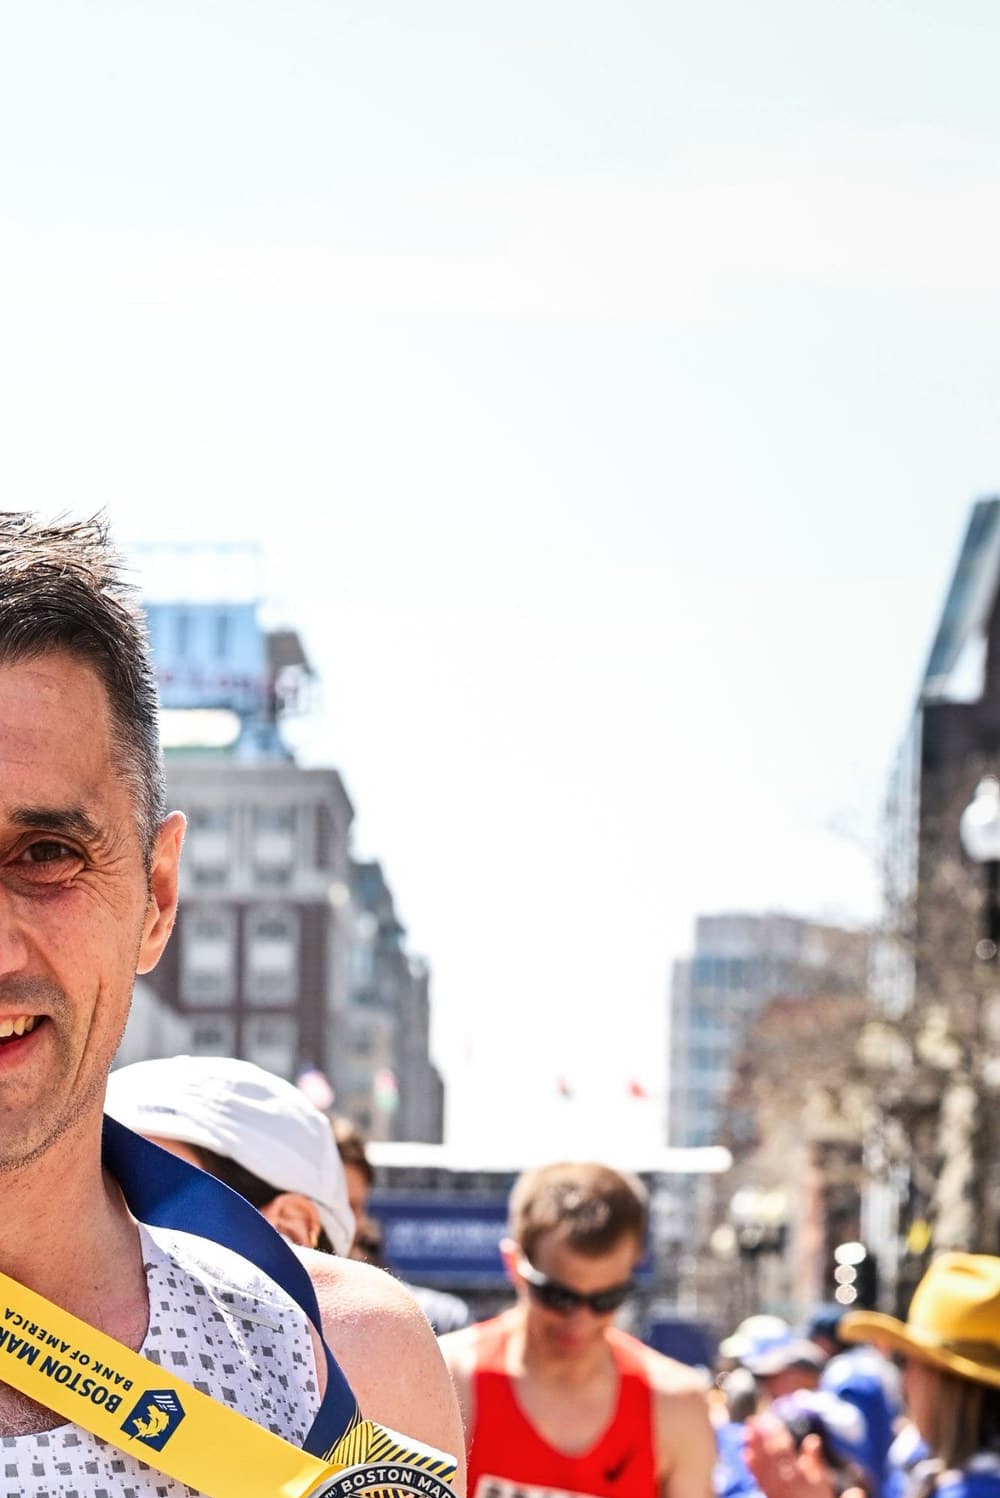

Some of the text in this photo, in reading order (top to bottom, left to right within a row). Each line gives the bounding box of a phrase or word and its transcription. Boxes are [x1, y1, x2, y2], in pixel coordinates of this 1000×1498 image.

[4, 1307, 134, 1391] BANK OF AMERICA
[39, 1355, 123, 1414] BOSTON
[341, 1468, 413, 1493] BOSTON
